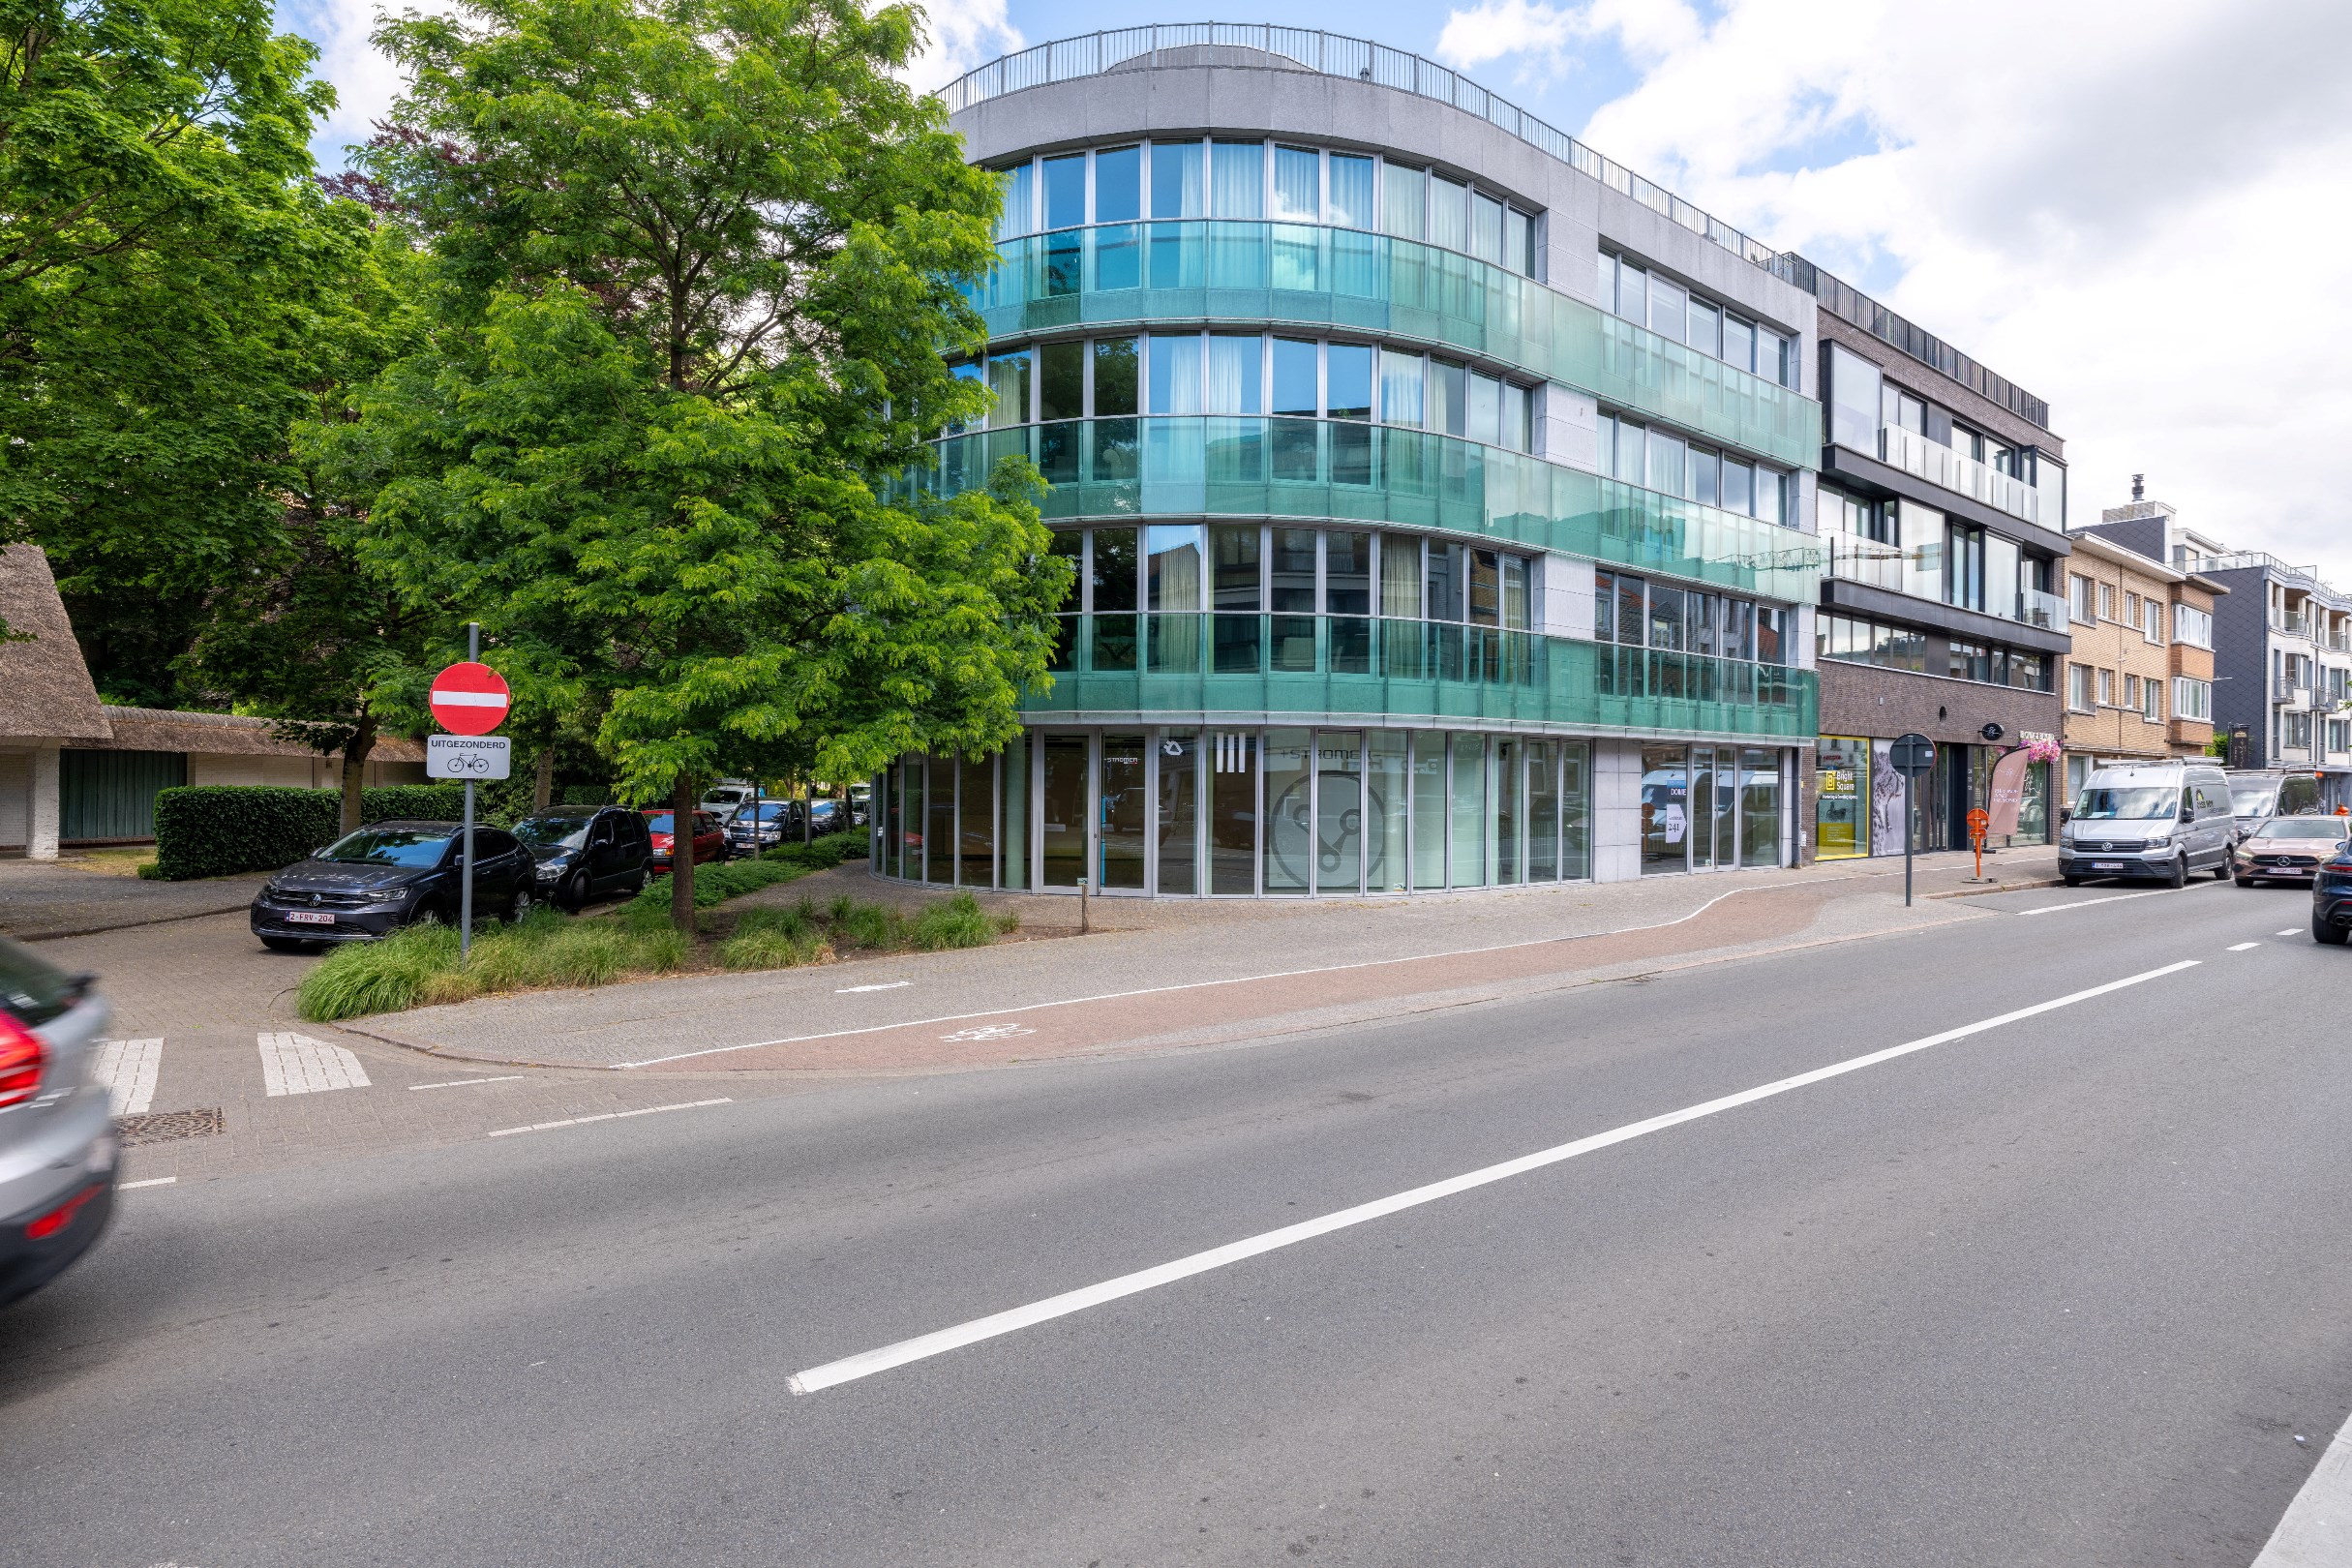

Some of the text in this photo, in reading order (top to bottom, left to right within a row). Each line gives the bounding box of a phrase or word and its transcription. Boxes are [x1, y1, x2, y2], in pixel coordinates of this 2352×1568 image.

[431, 739, 506, 749] UITGEZONDERD
[1836, 770, 1854, 782] Bright
[1836, 782, 1855, 792] Square
[1668, 823, 1679, 832] 241
